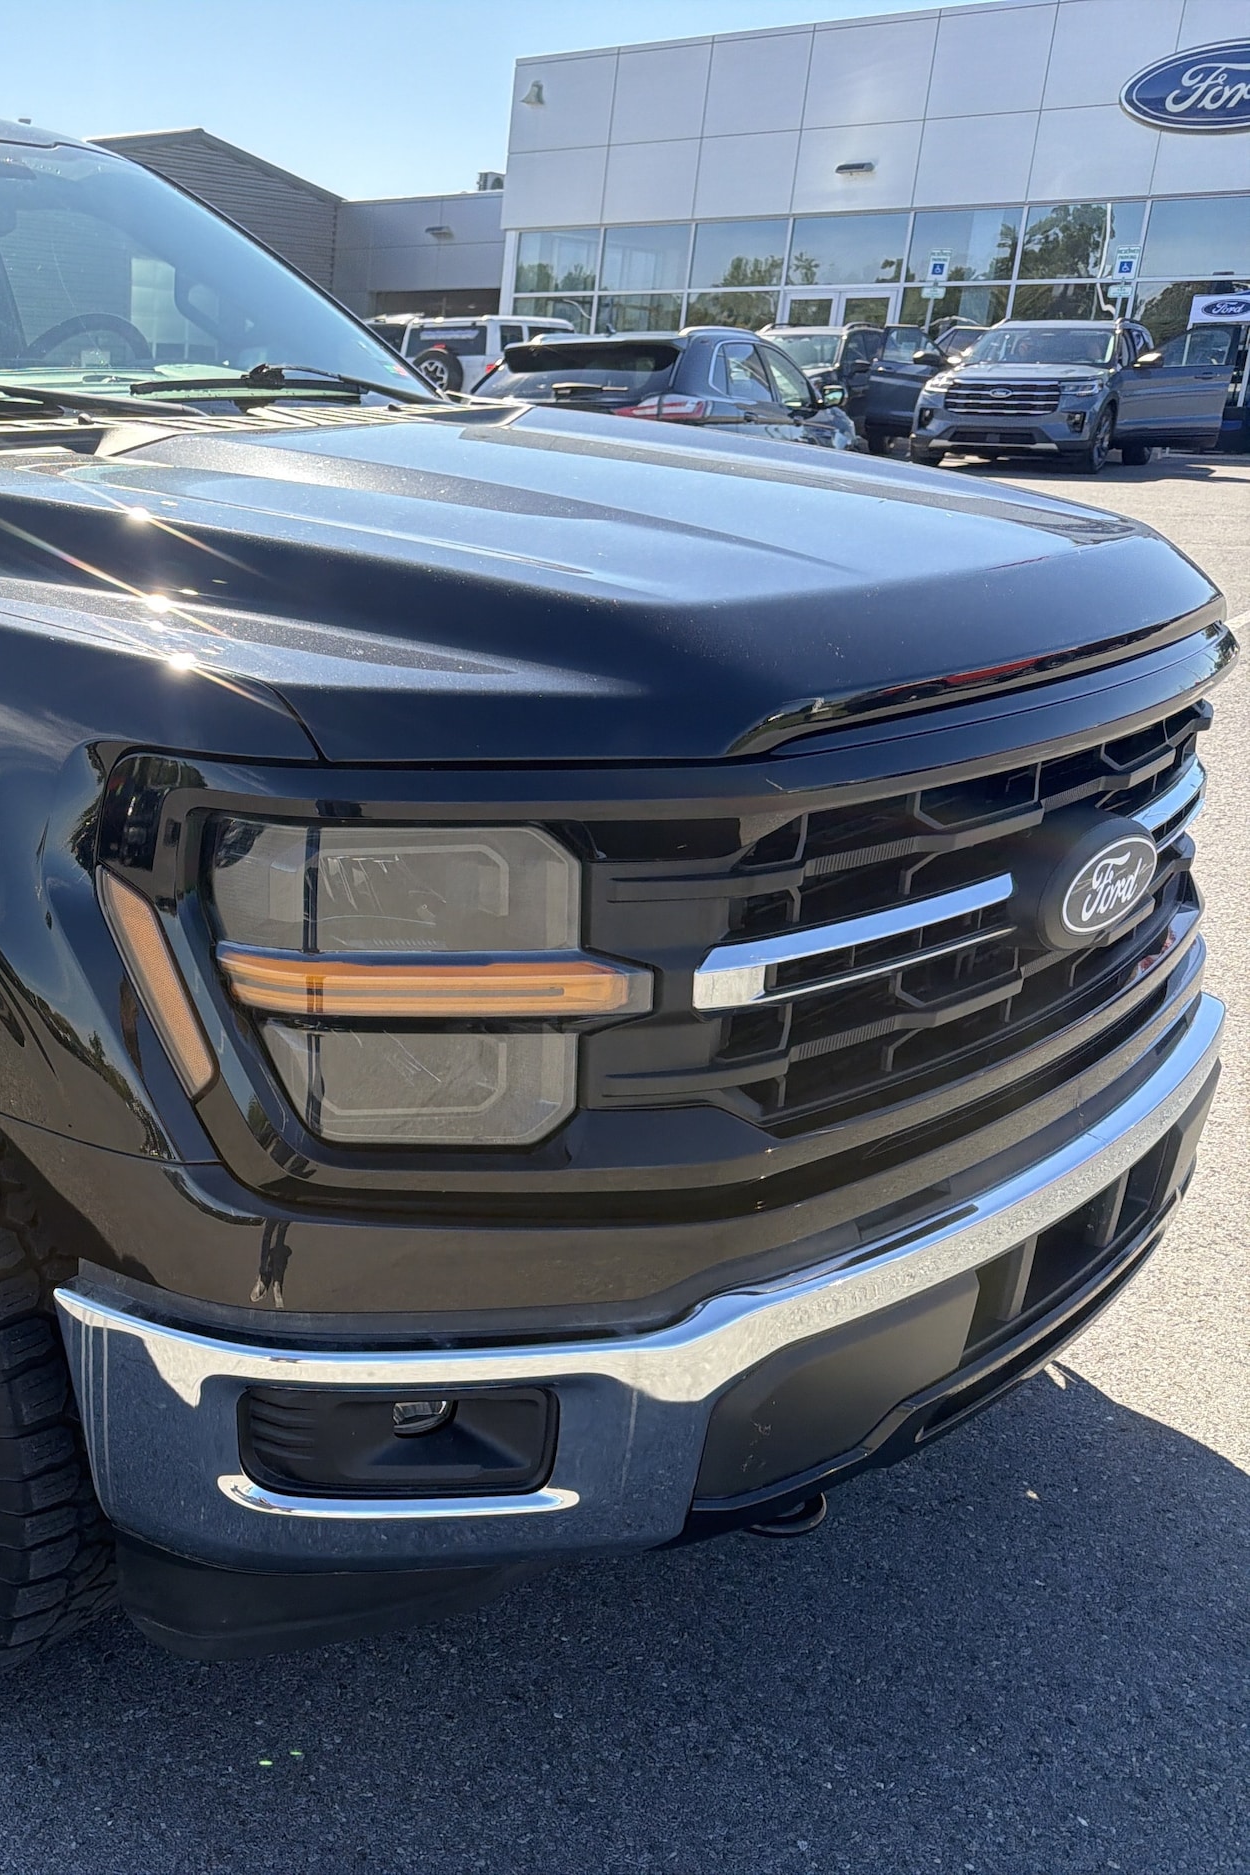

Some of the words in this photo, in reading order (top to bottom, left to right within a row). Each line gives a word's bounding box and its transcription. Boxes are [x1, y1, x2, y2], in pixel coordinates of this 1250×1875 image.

[1165, 62, 1250, 113] For
[1212, 301, 1245, 314] Ford
[1081, 851, 1143, 922] Ford
